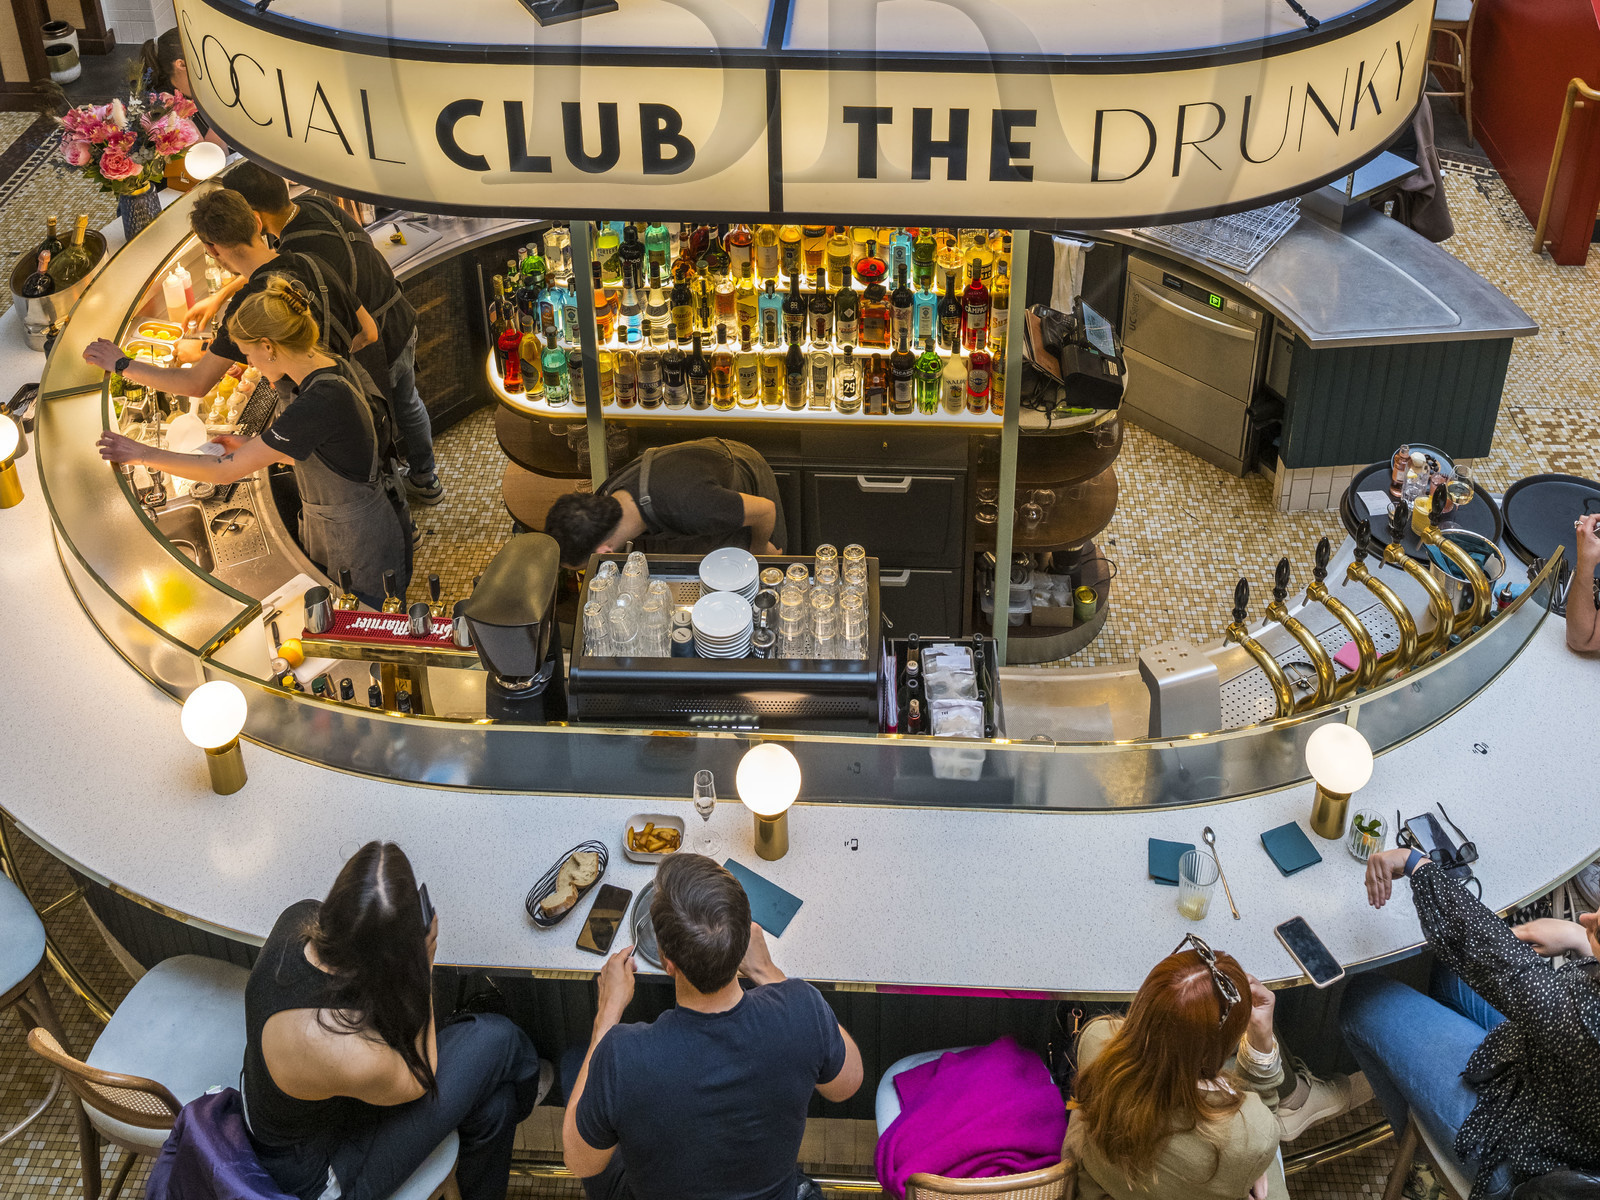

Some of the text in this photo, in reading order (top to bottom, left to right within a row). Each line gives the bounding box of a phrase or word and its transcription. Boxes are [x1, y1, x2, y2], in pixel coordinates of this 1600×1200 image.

[182, 9, 1419, 183] SOCIAL CLUB THE DRUNKY
[1128, 293, 1140, 331] UC Series
[844, 382, 856, 393] 29
